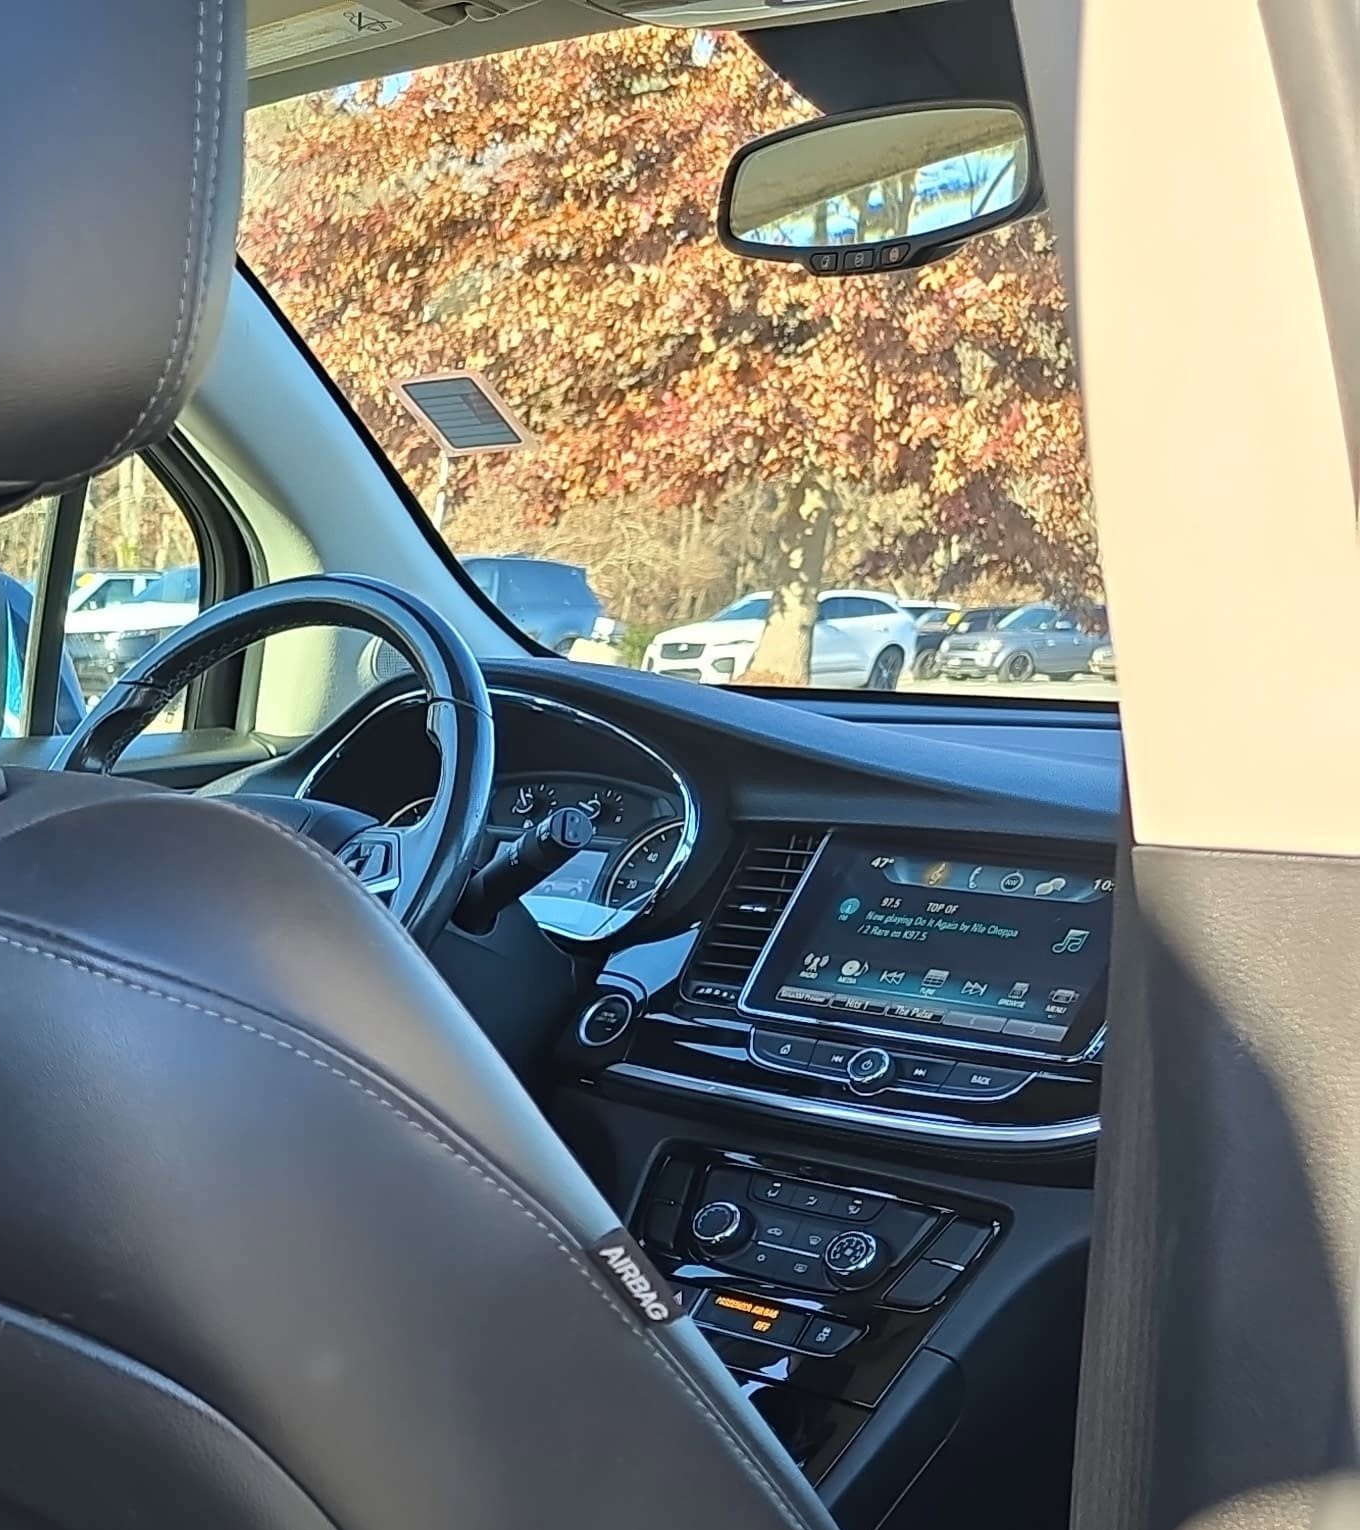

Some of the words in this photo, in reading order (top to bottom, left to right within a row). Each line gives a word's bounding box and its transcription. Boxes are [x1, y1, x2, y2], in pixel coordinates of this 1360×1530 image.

[881, 897, 902, 908] 97.5
[926, 902, 945, 913] TOP
[944, 904, 959, 914] OF
[883, 914, 913, 927] playing
[959, 922, 971, 933] by
[599, 1246, 669, 1321] AIRBAG
[752, 1319, 772, 1332] OFF
